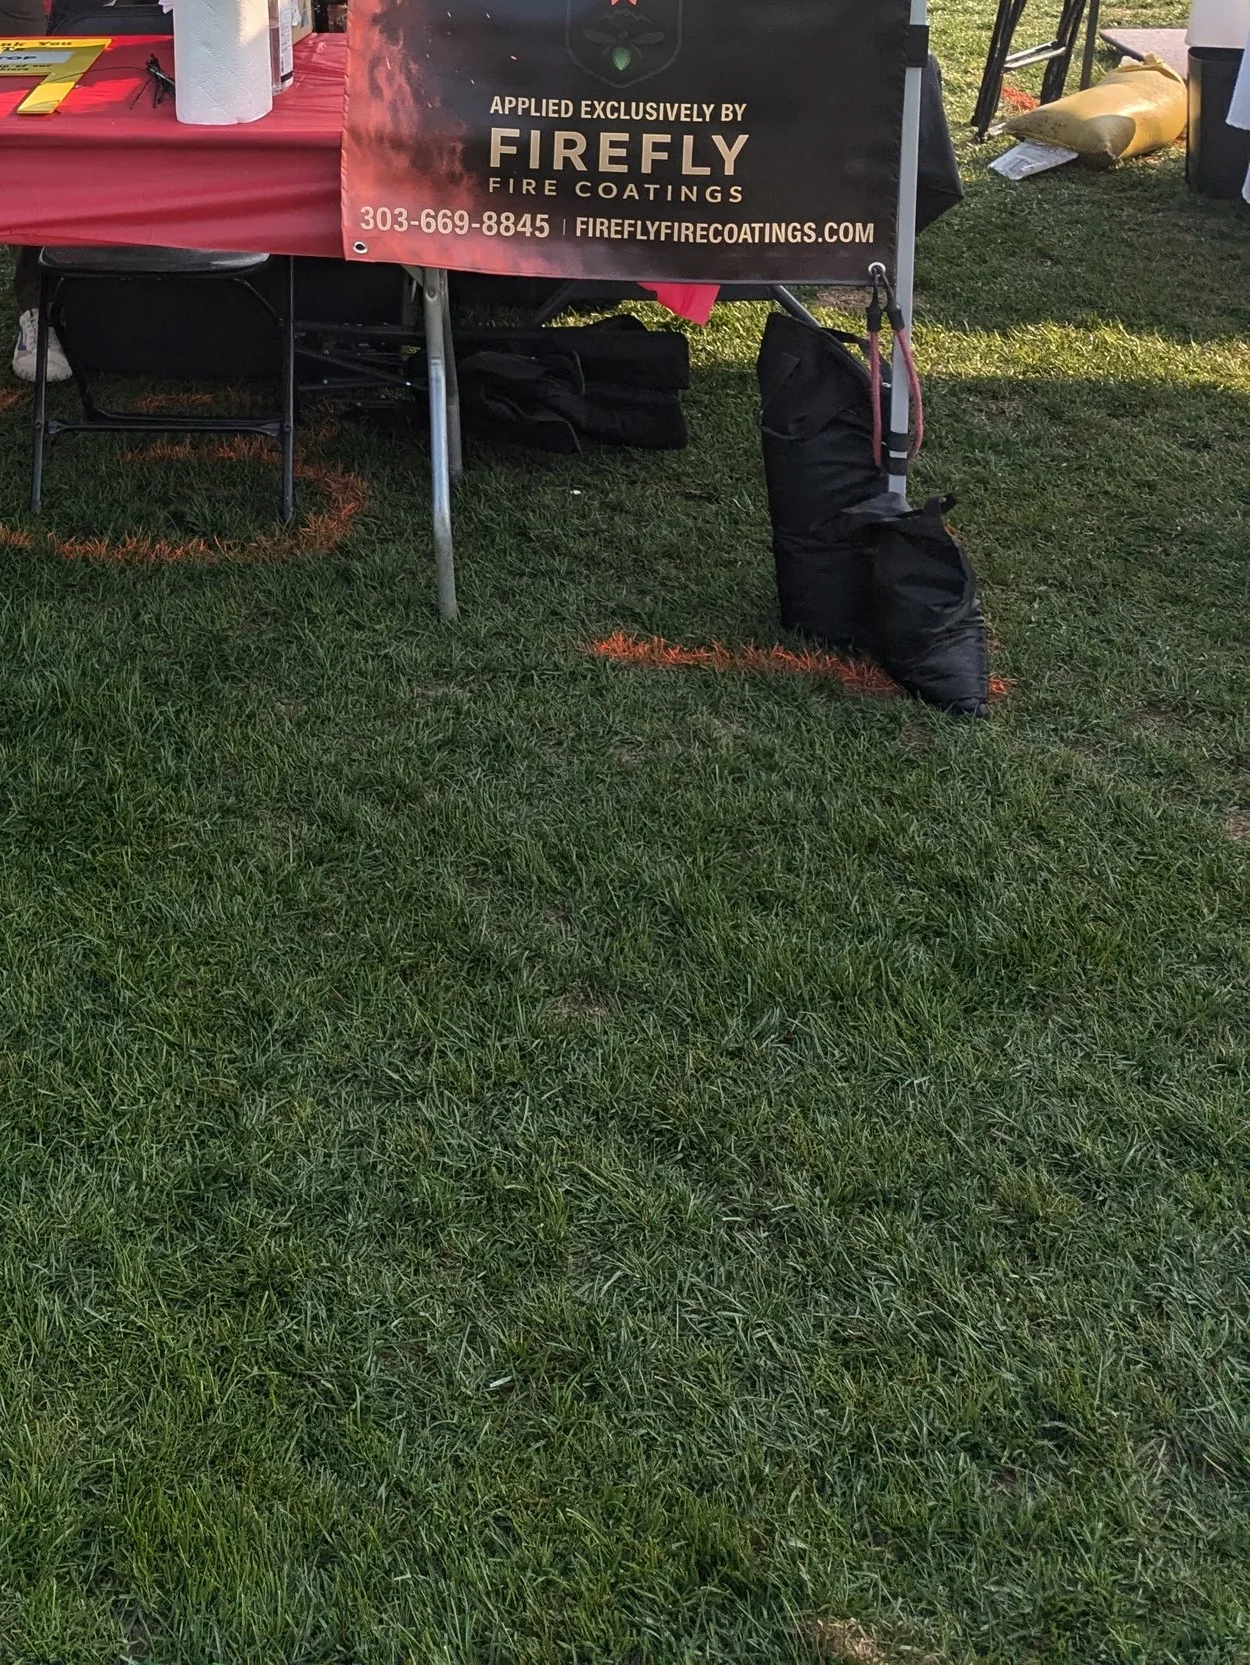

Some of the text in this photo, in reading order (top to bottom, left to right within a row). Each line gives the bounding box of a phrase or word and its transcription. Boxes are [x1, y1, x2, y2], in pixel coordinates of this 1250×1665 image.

[490, 95, 747, 123] APPLIED EXCLUSIVELY BY
[489, 127, 749, 176] FIREFLY
[489, 177, 743, 204] FIRE COATINGS
[360, 205, 875, 244] 303-669-8845 FIREFLYFIRECOATINGS.COM
